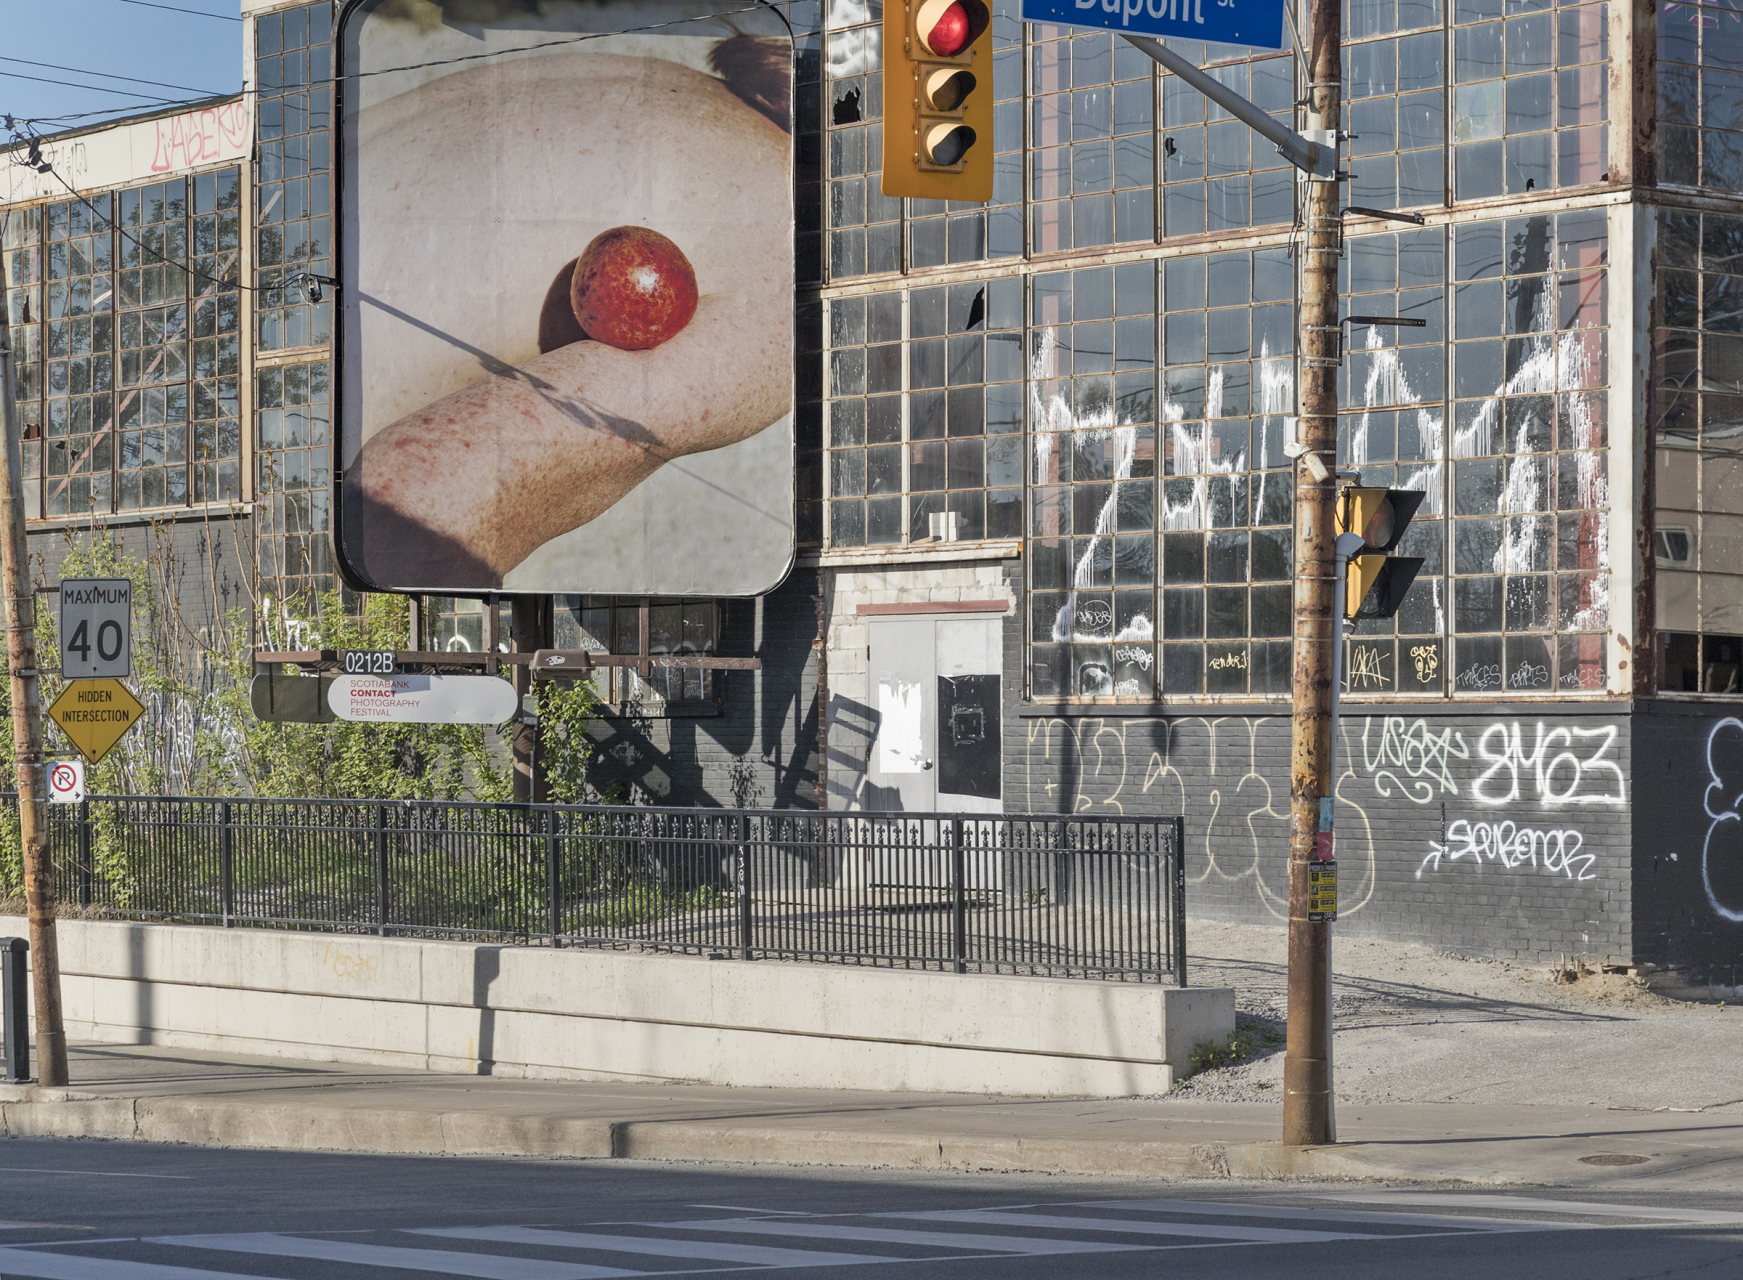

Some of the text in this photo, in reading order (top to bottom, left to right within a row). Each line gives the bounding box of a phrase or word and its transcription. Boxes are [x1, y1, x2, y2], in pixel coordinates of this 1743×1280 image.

[64, 589, 128, 605] MAXIMUM
[67, 619, 123, 662] 40
[345, 652, 394, 673] 0212B
[350, 679, 410, 689] SCOTIABANK
[77, 690, 112, 703] HIDDEN
[350, 689, 397, 697] CONTACT
[350, 699, 420, 708] PHOTOGRAPHY
[62, 709, 129, 723] INTERSECTION
[350, 708, 392, 717] FESTIVAL
